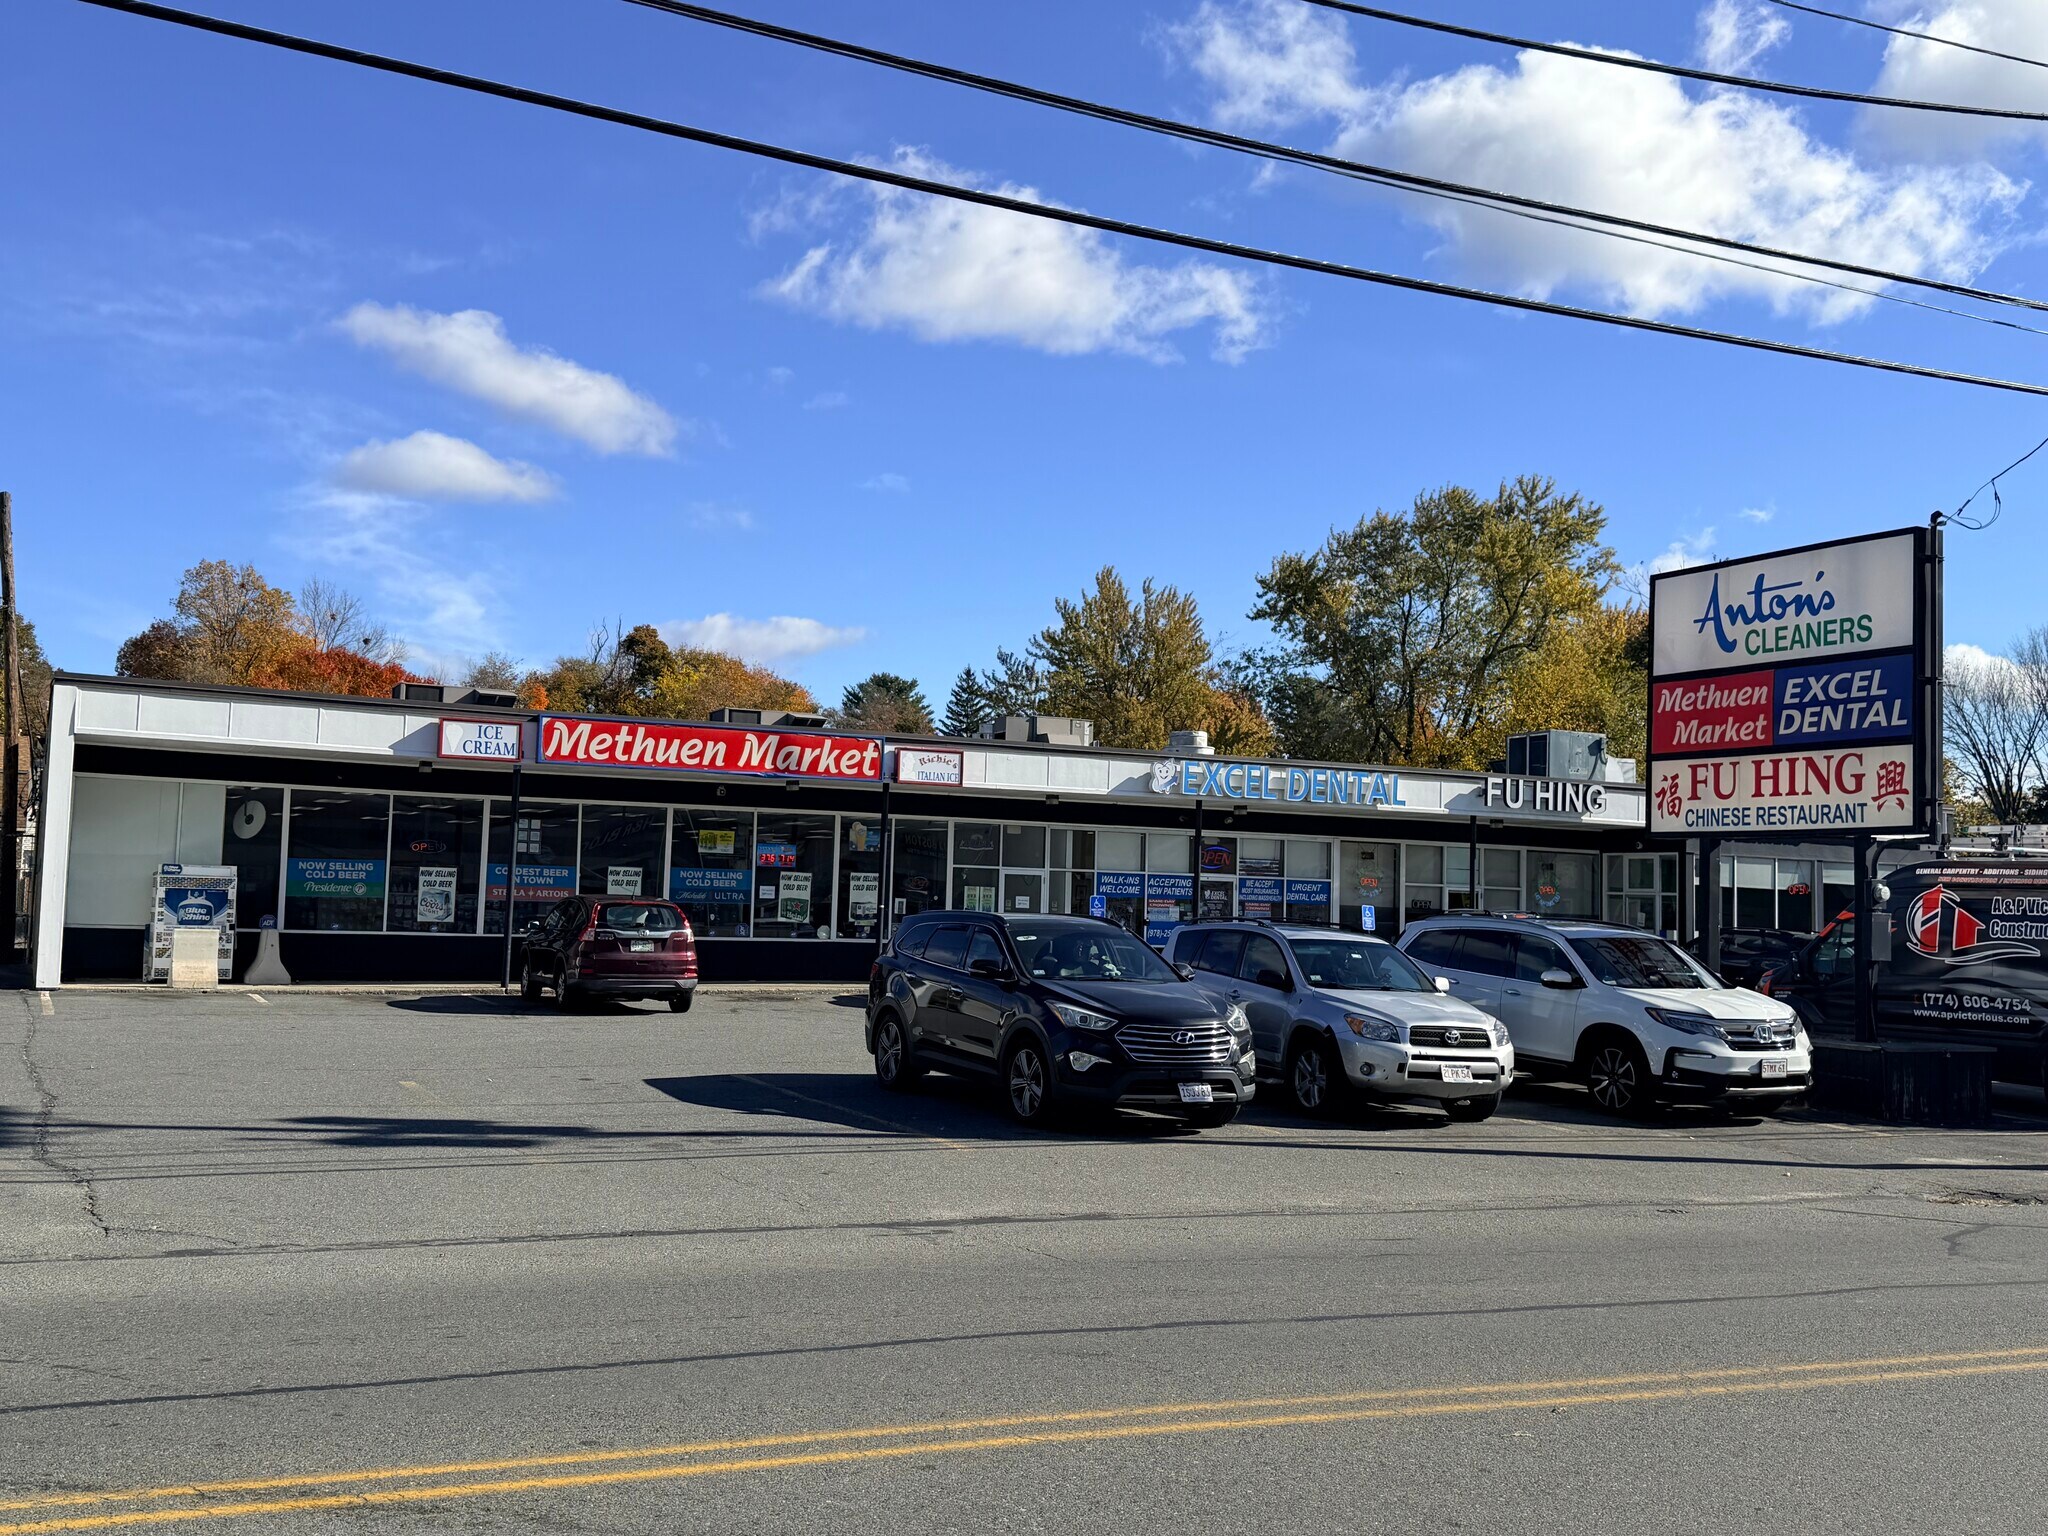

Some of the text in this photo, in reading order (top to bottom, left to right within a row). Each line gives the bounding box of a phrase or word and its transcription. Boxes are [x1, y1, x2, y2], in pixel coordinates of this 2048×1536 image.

[1693, 570, 1835, 653] Anton's
[1745, 614, 1873, 656] CLEANERS
[1783, 669, 1888, 705] EXCEL
[1657, 683, 1768, 714] Methuen
[1778, 698, 1908, 735] DENTAL
[477, 725, 503, 740] ICE
[1672, 713, 1767, 746] Market
[463, 740, 516, 756] CREAM
[545, 721, 880, 777] Methuen Market
[917, 771, 960, 782] ITALIAN ICE
[1687, 753, 1866, 800] FU HING
[1181, 760, 1406, 806] EXCEL DENTAL
[1871, 760, 1910, 812] 興
[1487, 777, 1607, 815] FU HING
[1655, 772, 1682, 820] 福
[1684, 802, 1868, 828] CHINESE RESTAURANT
[411, 843, 444, 852] OPEN
[299, 861, 374, 871] NOW SELLING
[305, 870, 366, 880] COLD BEER
[420, 869, 456, 878] NOW SELLING
[495, 867, 569, 877] CODEST BEER
[608, 869, 641, 878] NOW SELLING
[680, 870, 743, 880] NOW SELLING
[1983, 868, 2019, 876] ADDITIONS
[438, 880, 453, 888] BEER
[522, 876, 554, 885] TOWN
[610, 879, 624, 887] COLD
[686, 879, 736, 888] COLD BEER
[793, 875, 811, 883] SELLING
[1101, 875, 1140, 884] WALK-INS
[1148, 878, 1192, 887] ACCEPTING
[1254, 880, 1275, 888] ACCEPT
[303, 881, 352, 893] Presidente
[783, 883, 795, 891] COLD
[1100, 885, 1140, 894] WELCOME
[1148, 887, 1193, 896] NEW PATIENTS
[1291, 883, 1322, 892] URGENT
[1788, 884, 1810, 895] OPEN
[492, 888, 569, 897] STELA ARTOIS
[714, 891, 745, 900] ULTRA
[1287, 893, 1328, 902] DENTAL CARE
[420, 897, 443, 911] Coors
[1412, 899, 1432, 909] OPEN
[1991, 896, 2002, 915] A
[2003, 898, 2015, 915] &
[2014, 896, 2026, 915] P
[423, 907, 439, 915] LIGHT
[1923, 993, 2031, 1011] (774) 606-4754
[1913, 1009, 2030, 1024] www.apvictorious.com
